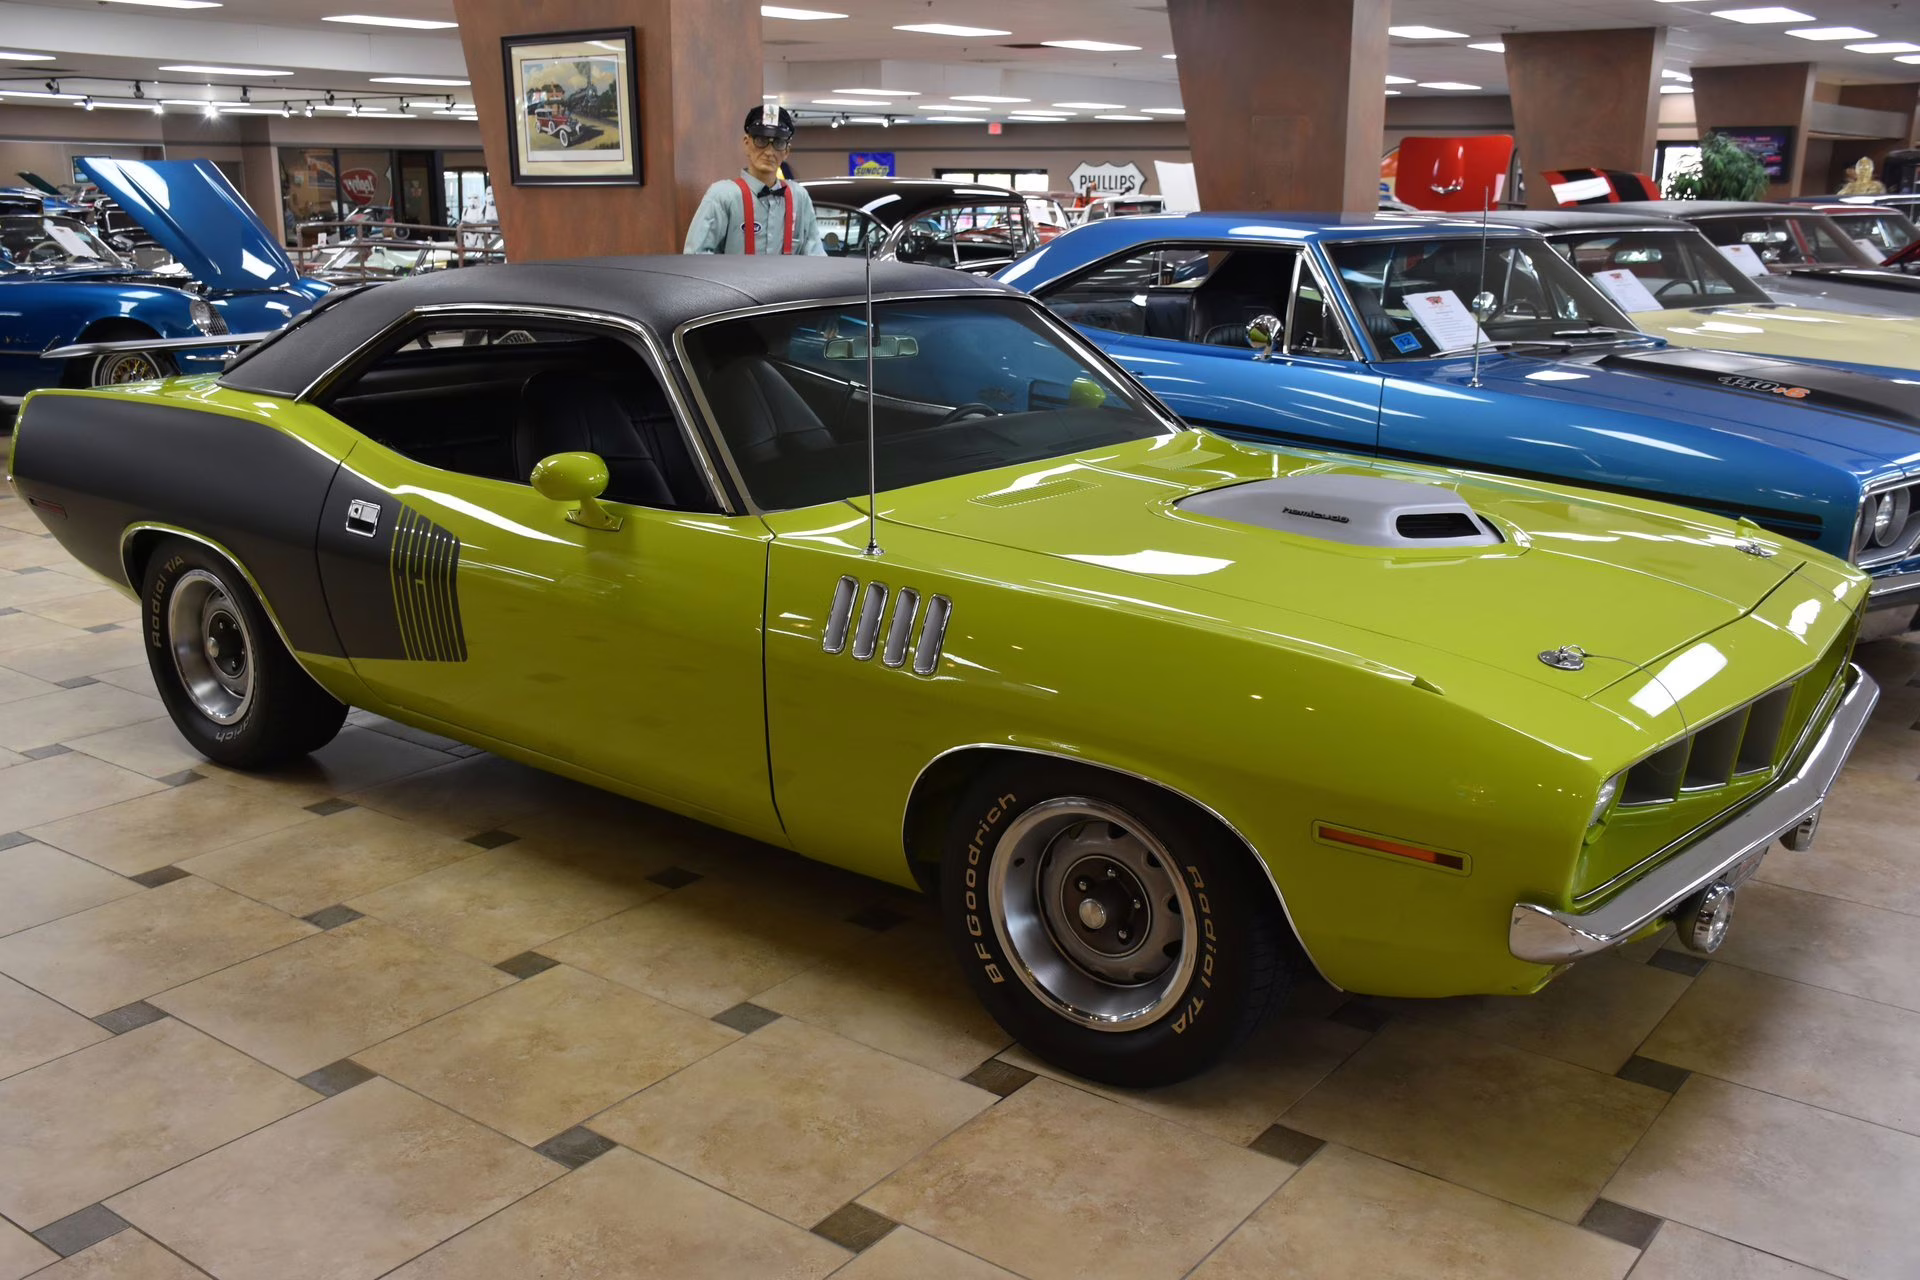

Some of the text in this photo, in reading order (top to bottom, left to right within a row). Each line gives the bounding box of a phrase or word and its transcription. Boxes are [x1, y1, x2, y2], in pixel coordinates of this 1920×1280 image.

[1080, 175, 1135, 190] PHILLIPS
[152, 555, 185, 649] Radial T/A
[965, 792, 1017, 985] BFGoodrich
[1171, 865, 1217, 1036] Radial T/A
